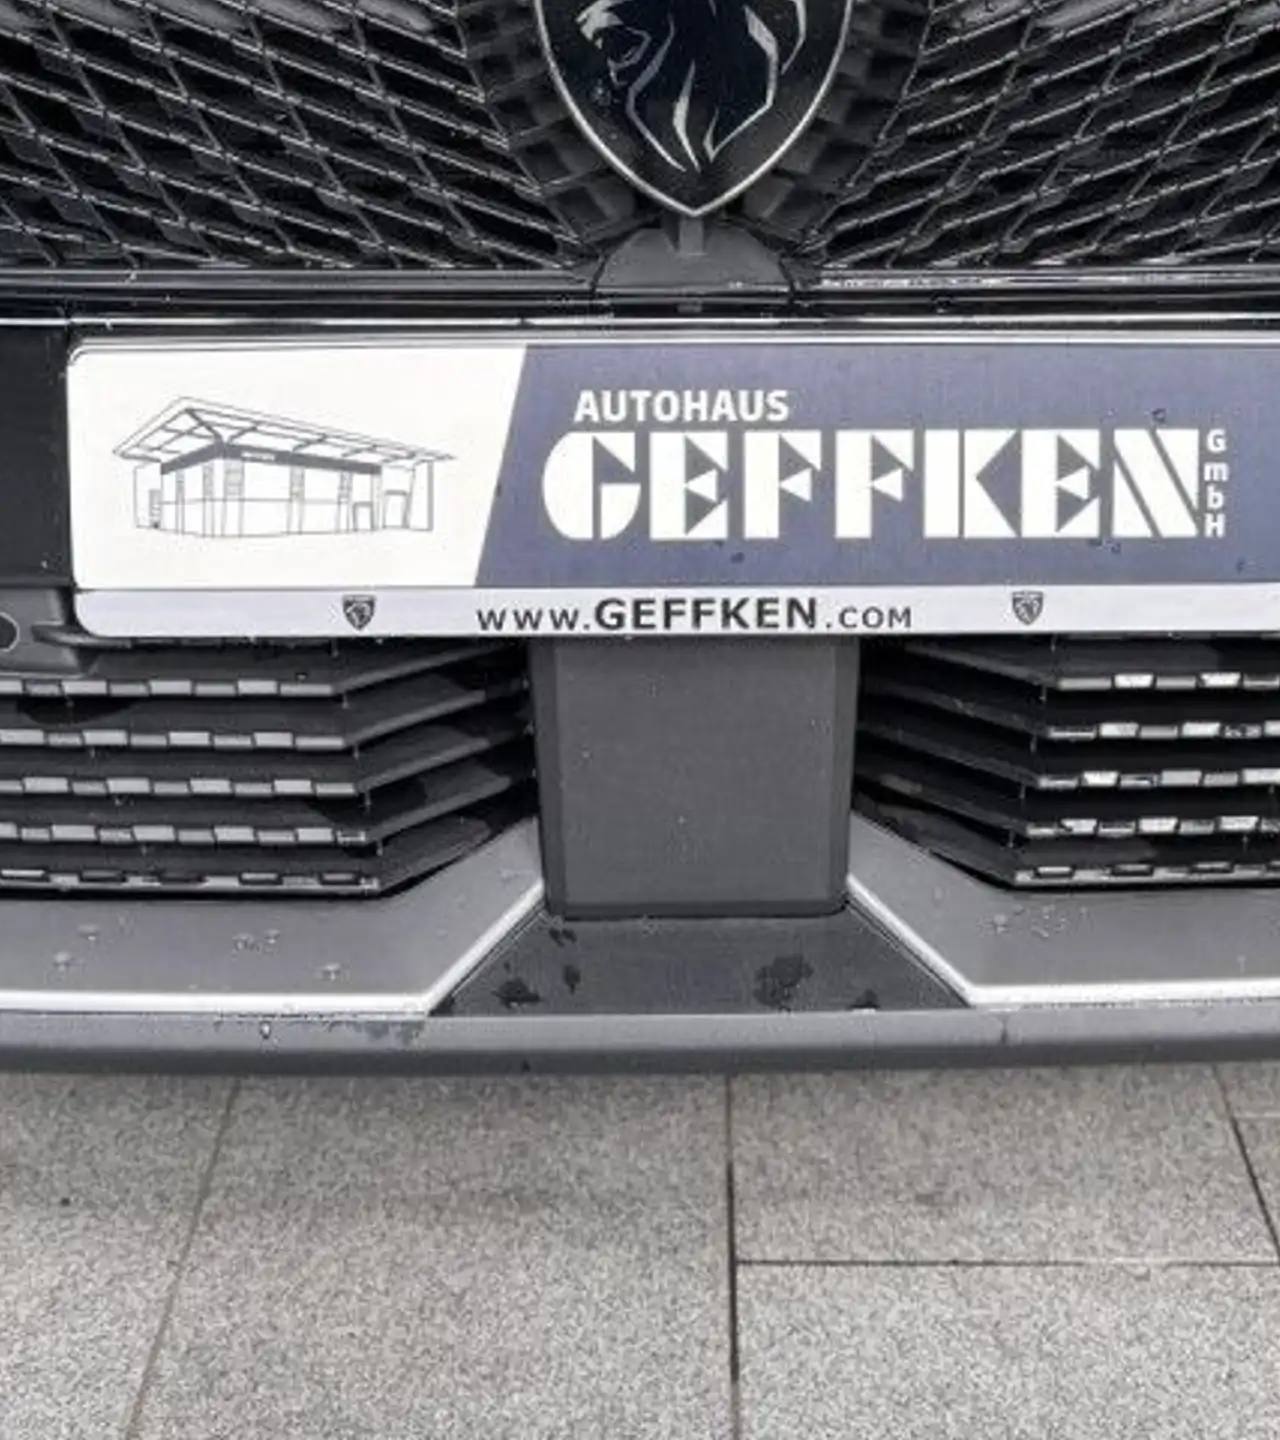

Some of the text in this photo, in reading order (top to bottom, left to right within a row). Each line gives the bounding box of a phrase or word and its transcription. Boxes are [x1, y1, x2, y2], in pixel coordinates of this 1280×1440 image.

[573, 389, 790, 422] AUTOHAUS
[541, 428, 1200, 541] GEFFKEN
[1203, 429, 1229, 538] GmbH
